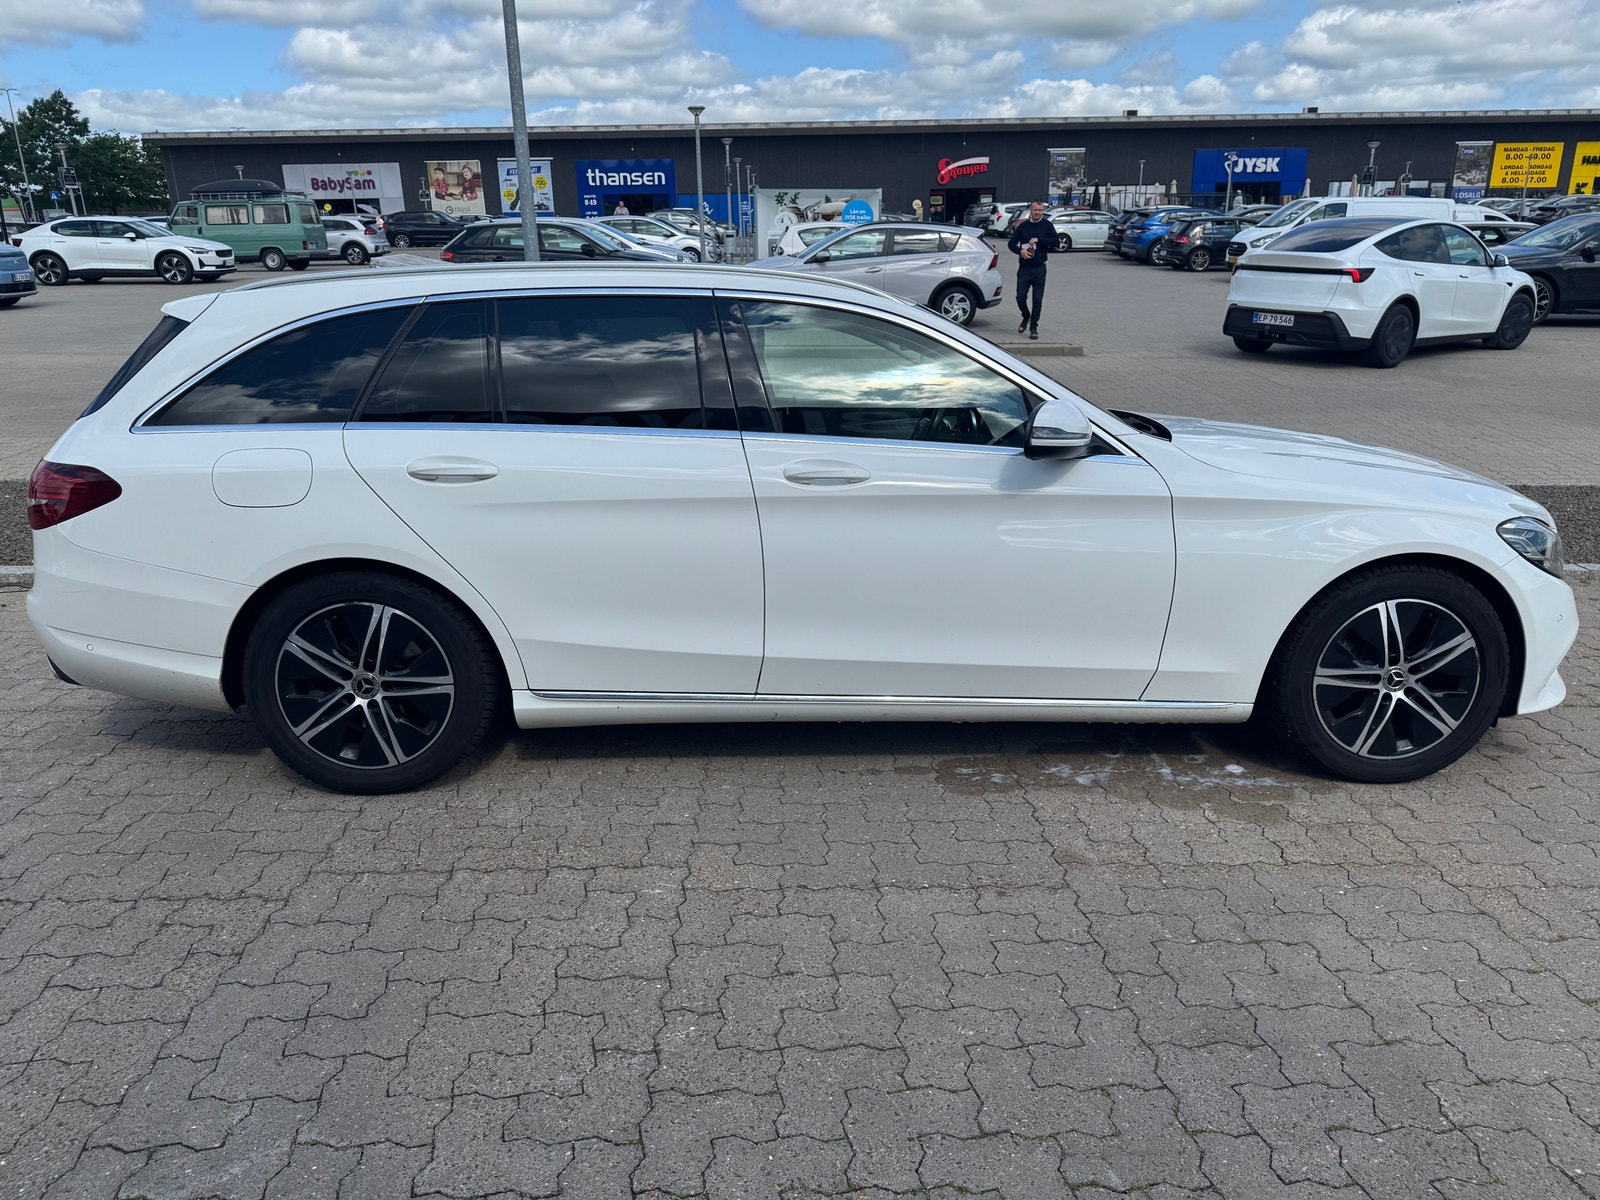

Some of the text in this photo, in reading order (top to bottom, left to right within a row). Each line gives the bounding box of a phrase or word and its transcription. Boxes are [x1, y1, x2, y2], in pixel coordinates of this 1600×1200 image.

[1233, 157, 1281, 173] JYSK
[311, 176, 376, 193] BabySam
[586, 168, 666, 186] thansen
[1258, 313, 1293, 325] EP 79 546
